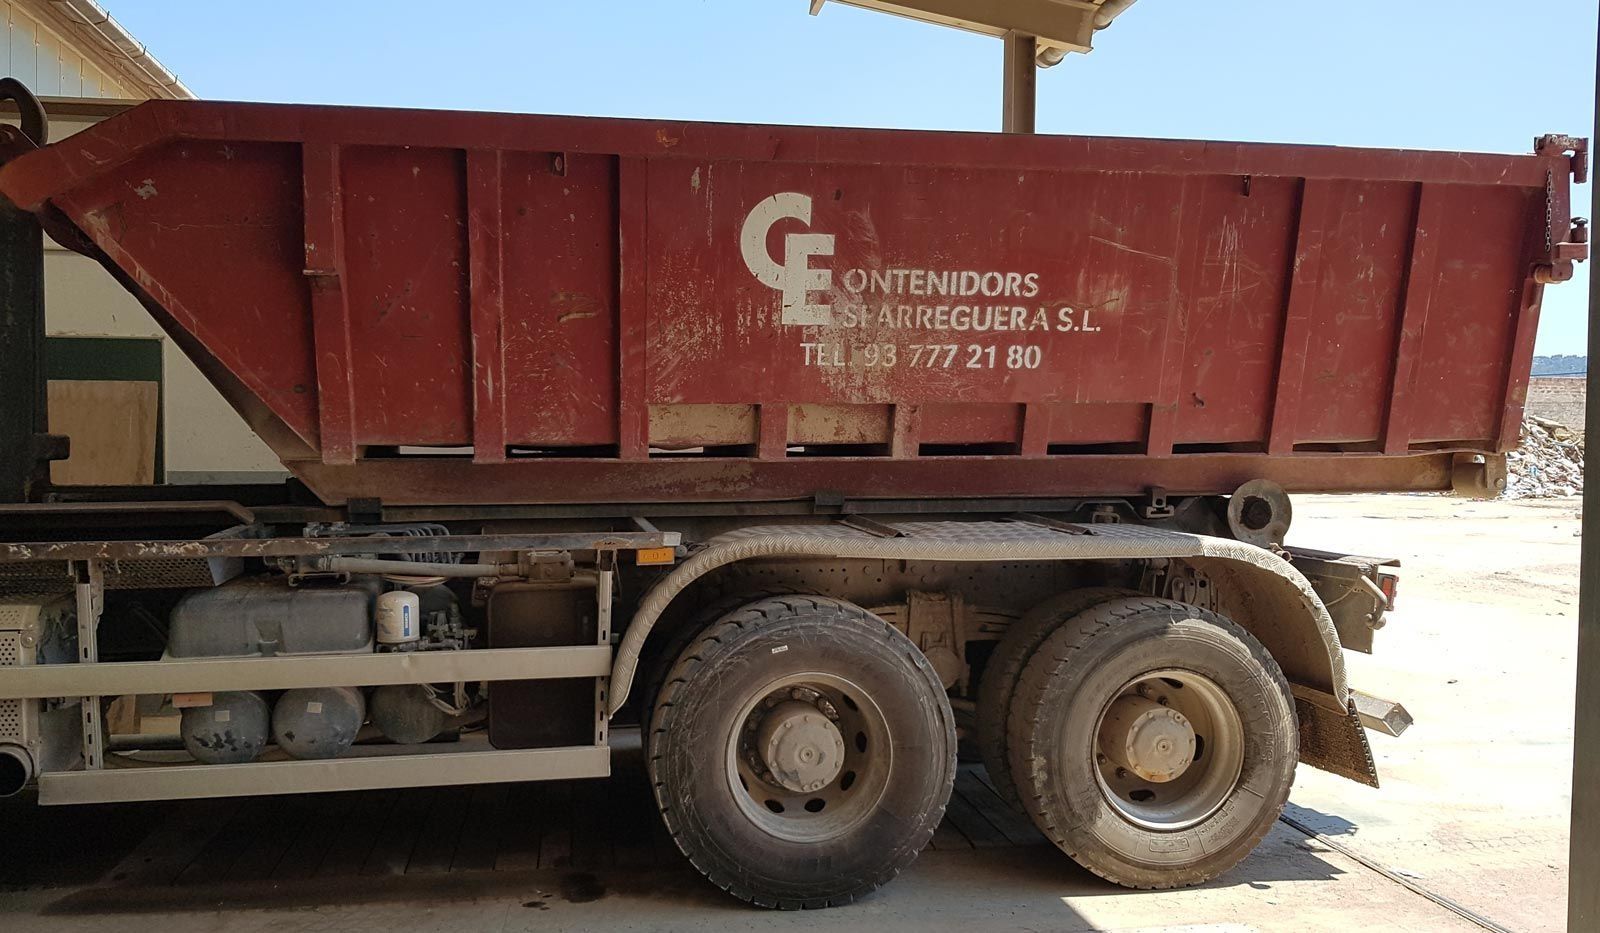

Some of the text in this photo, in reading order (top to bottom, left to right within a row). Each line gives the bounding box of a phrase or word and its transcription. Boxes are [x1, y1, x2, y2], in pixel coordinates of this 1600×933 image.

[842, 268, 1039, 298] ONTENIDORS
[1056, 307, 1101, 332] S.L.
[800, 343, 1042, 369] TEL. 93 777 21 80
